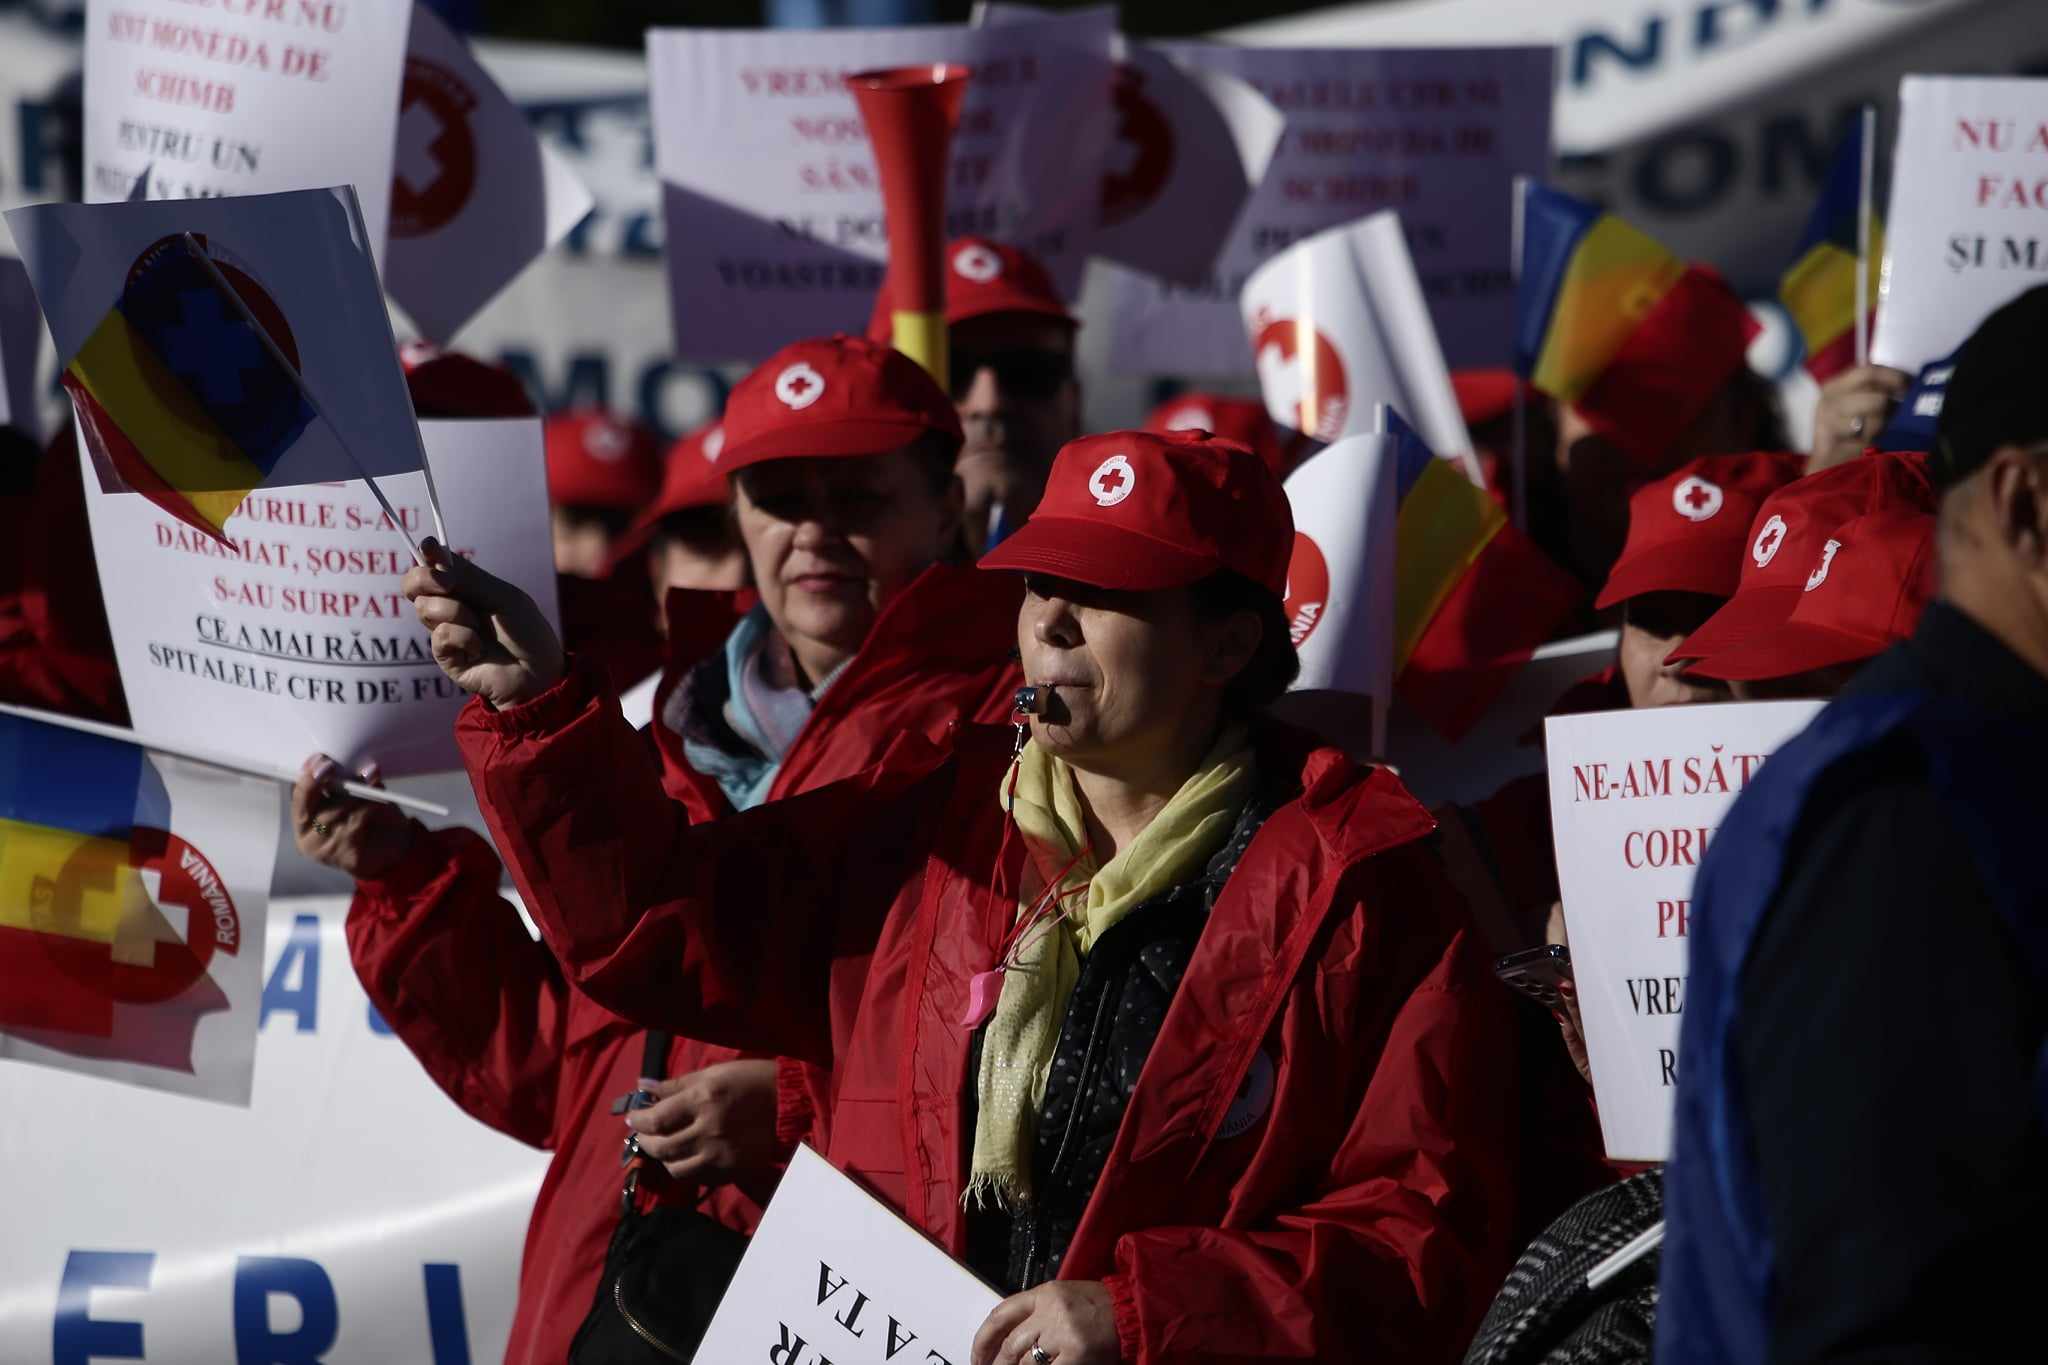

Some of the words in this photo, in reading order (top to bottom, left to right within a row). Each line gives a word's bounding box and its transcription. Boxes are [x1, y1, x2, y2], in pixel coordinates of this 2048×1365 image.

[151, 20, 270, 69] MONEDA
[280, 45, 331, 81] DE
[1955, 119, 2016, 152] NU
[213, 577, 274, 607] S-AU
[281, 587, 403, 619] SURPAT
[196, 615, 230, 642] CE
[238, 622, 258, 645] A
[261, 628, 316, 655] MAI
[324, 630, 433, 662] RĂMA
[148, 642, 283, 695] SPITALELE
[288, 676, 347, 704] CFR
[357, 681, 403, 705] DE
[1572, 758, 1672, 802] NE-AM
[1683, 743, 1775, 794] SĂT
[1626, 976, 1689, 1016] VRE
